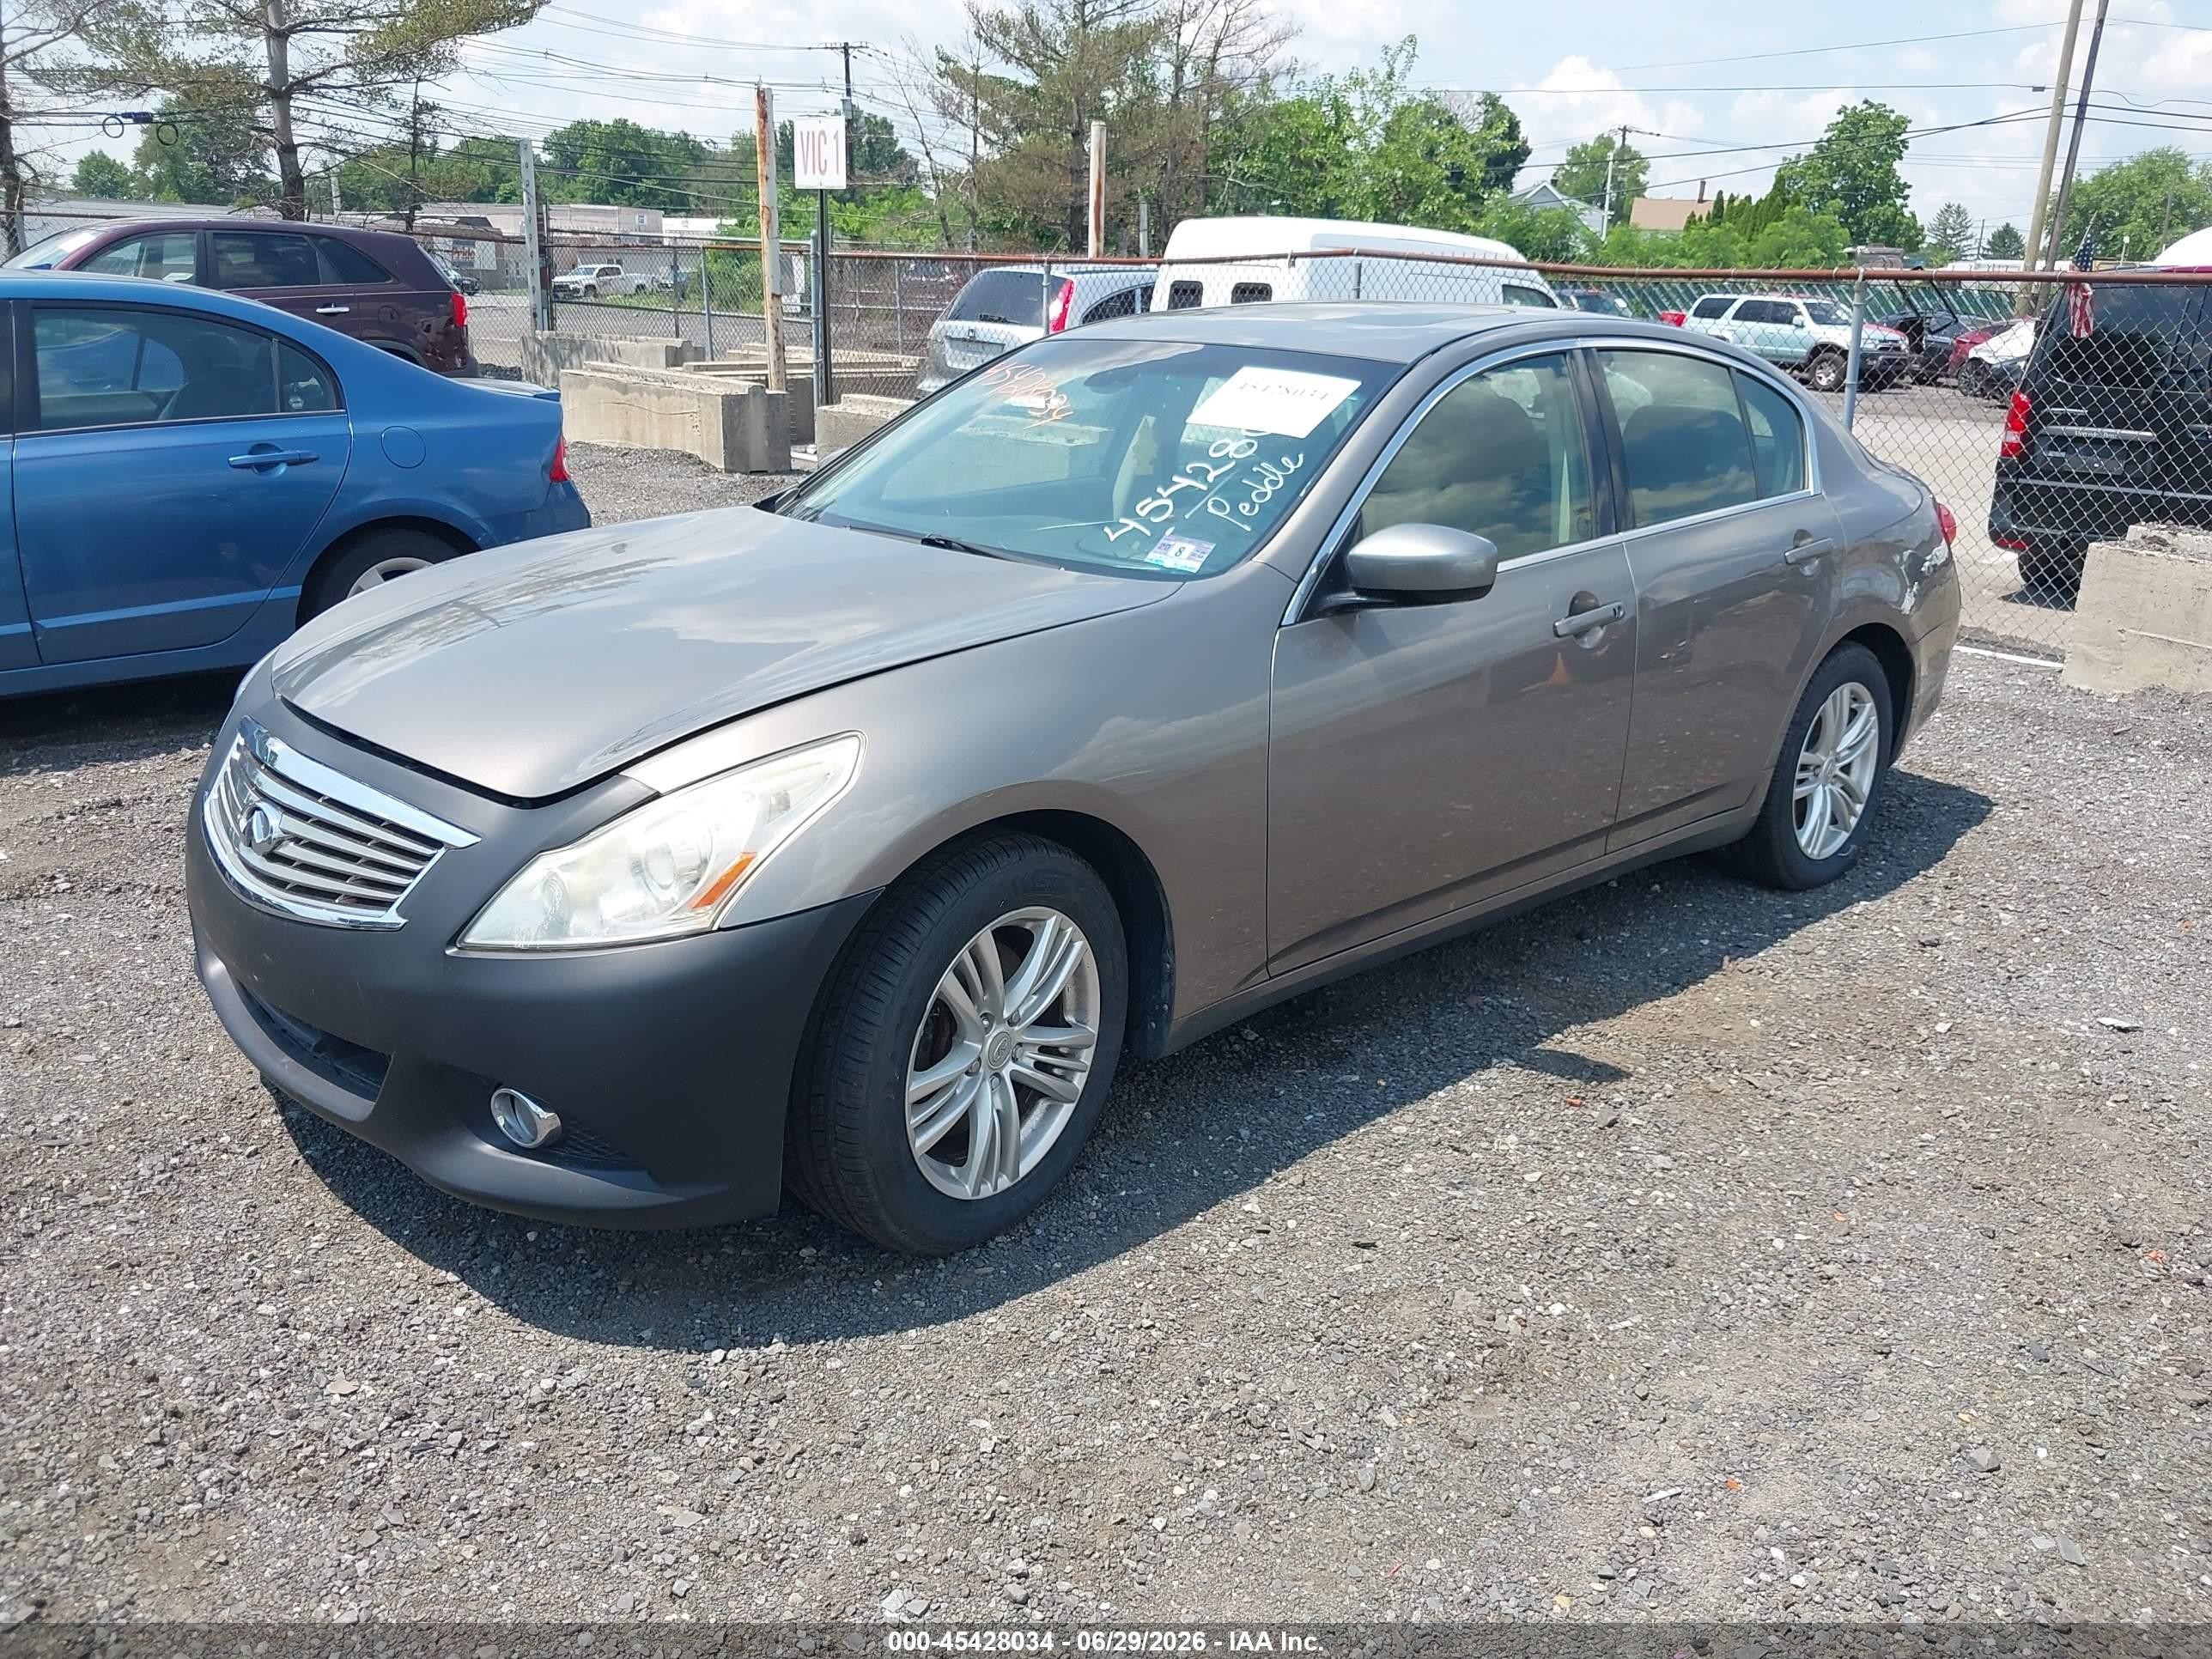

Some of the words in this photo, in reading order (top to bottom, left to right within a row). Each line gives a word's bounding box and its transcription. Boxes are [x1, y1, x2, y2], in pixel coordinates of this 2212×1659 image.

[799, 130, 827, 176] VIC
[833, 130, 840, 176] 1
[1206, 453, 1304, 532] Peddle
